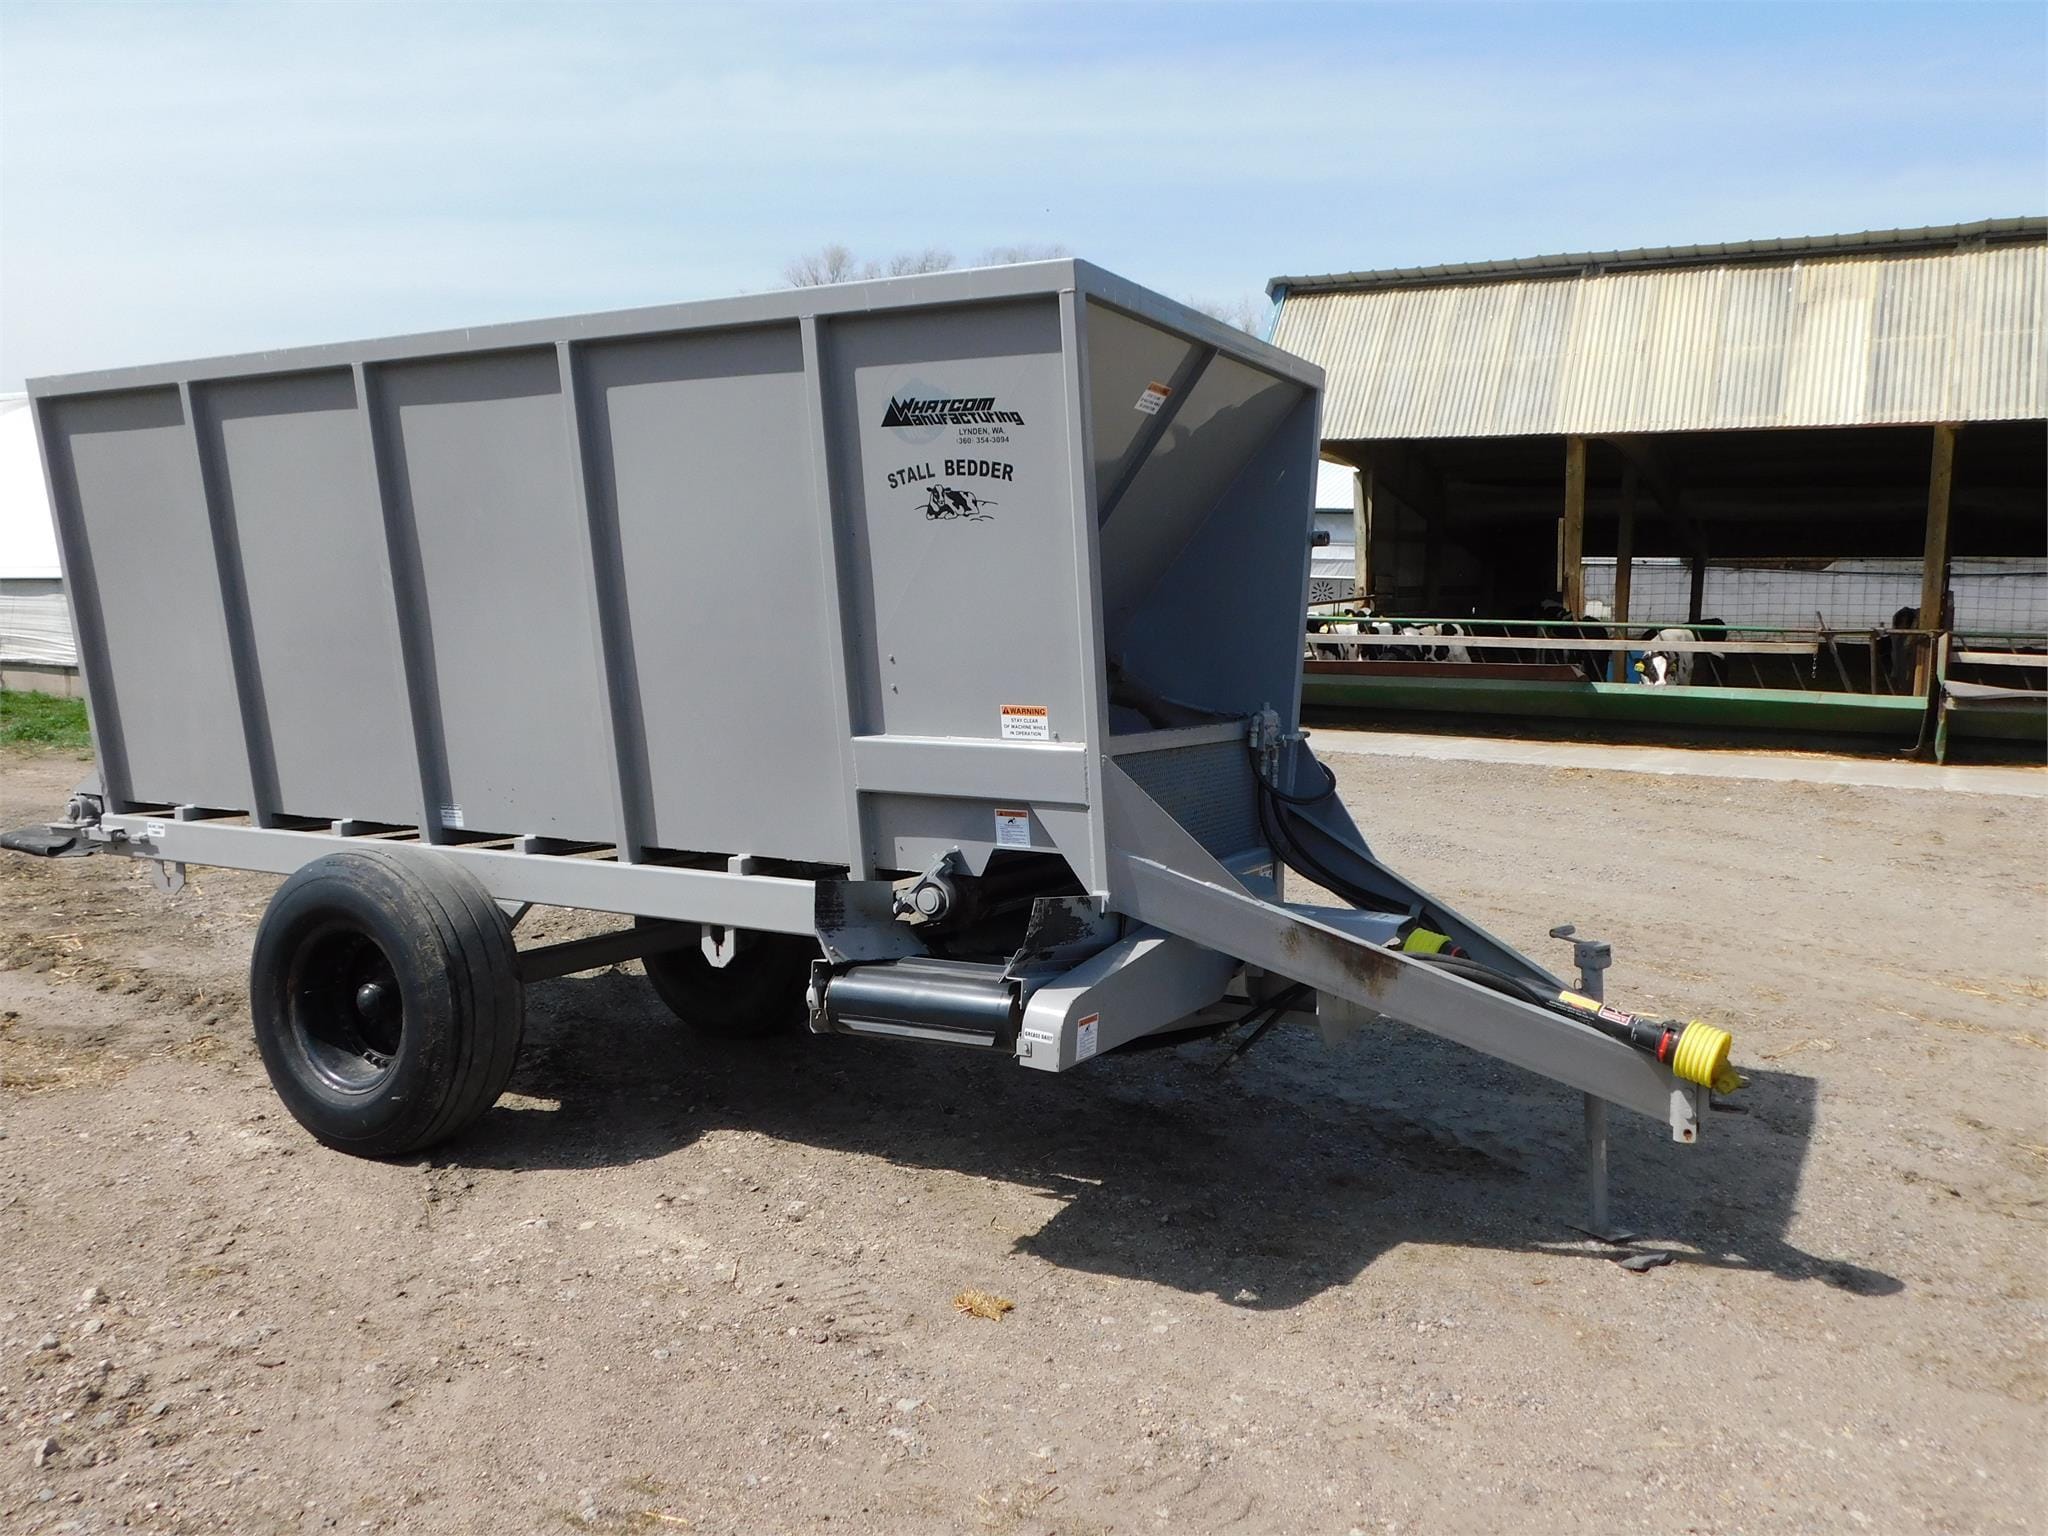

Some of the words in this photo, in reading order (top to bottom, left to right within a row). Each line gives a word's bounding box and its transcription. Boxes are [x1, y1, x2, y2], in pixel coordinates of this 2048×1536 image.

[887, 462, 936, 489] STALL
[944, 459, 1014, 482] BEDDER
[1010, 707, 1046, 715] WARNING
